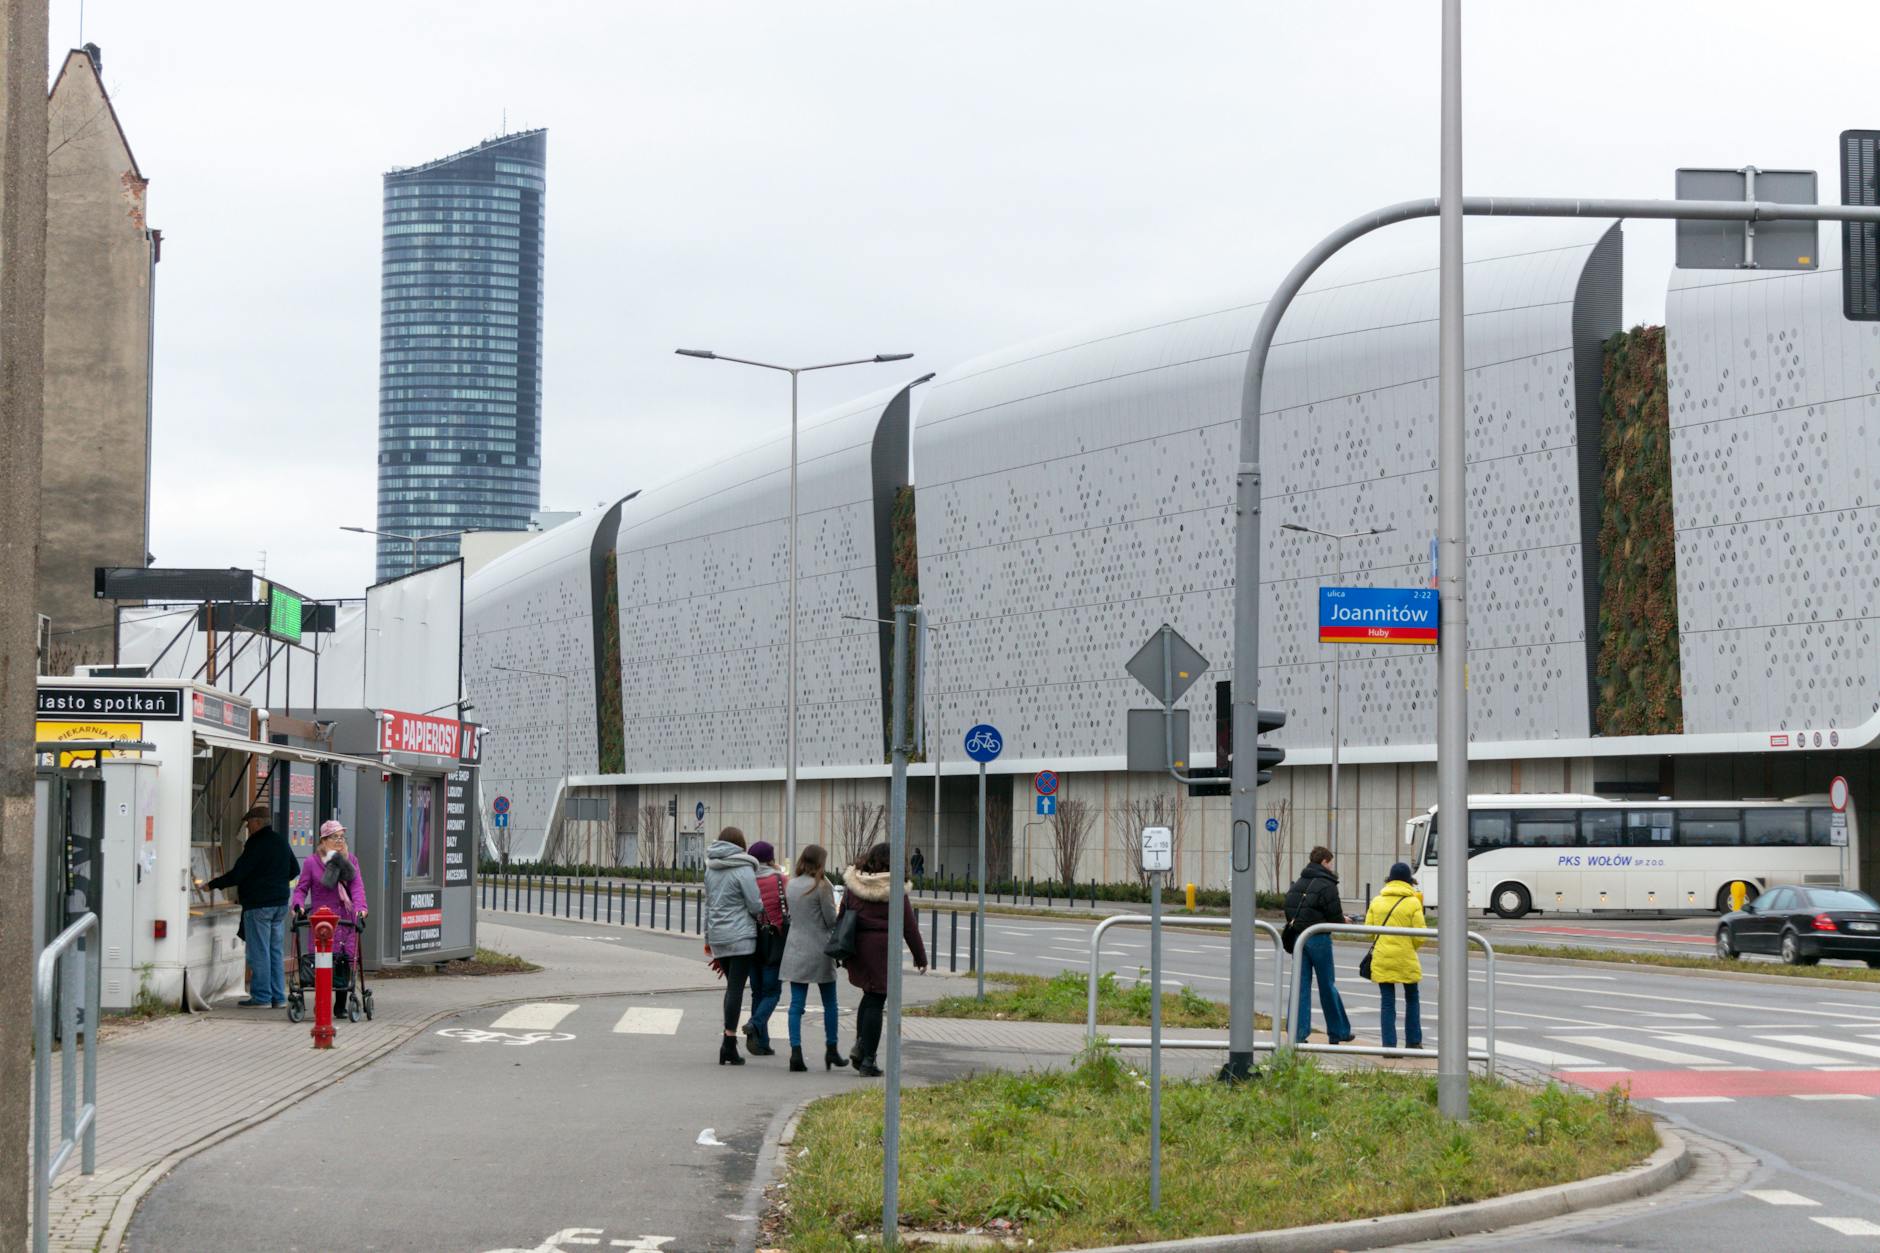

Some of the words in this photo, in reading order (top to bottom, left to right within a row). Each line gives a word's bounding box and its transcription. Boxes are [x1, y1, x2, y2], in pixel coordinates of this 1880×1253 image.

[1327, 590, 1346, 598] ulica
[1413, 591, 1432, 599] 2-22
[1331, 604, 1428, 622] Joannitów
[1368, 629, 1389, 638] Huby
[39, 694, 86, 709] iasto
[93, 693, 166, 713] spotkań
[58, 726, 109, 741] PIEKARNIA
[385, 720, 393, 748] E
[402, 719, 459, 754] PAPIEROSY
[459, 770, 470, 781] SHOP
[446, 835, 458, 848] BAZY
[1144, 836, 1152, 848] Z
[1558, 856, 1581, 866] PKS
[1587, 854, 1632, 866] WOŁÓW
[411, 893, 434, 909] PARKING
